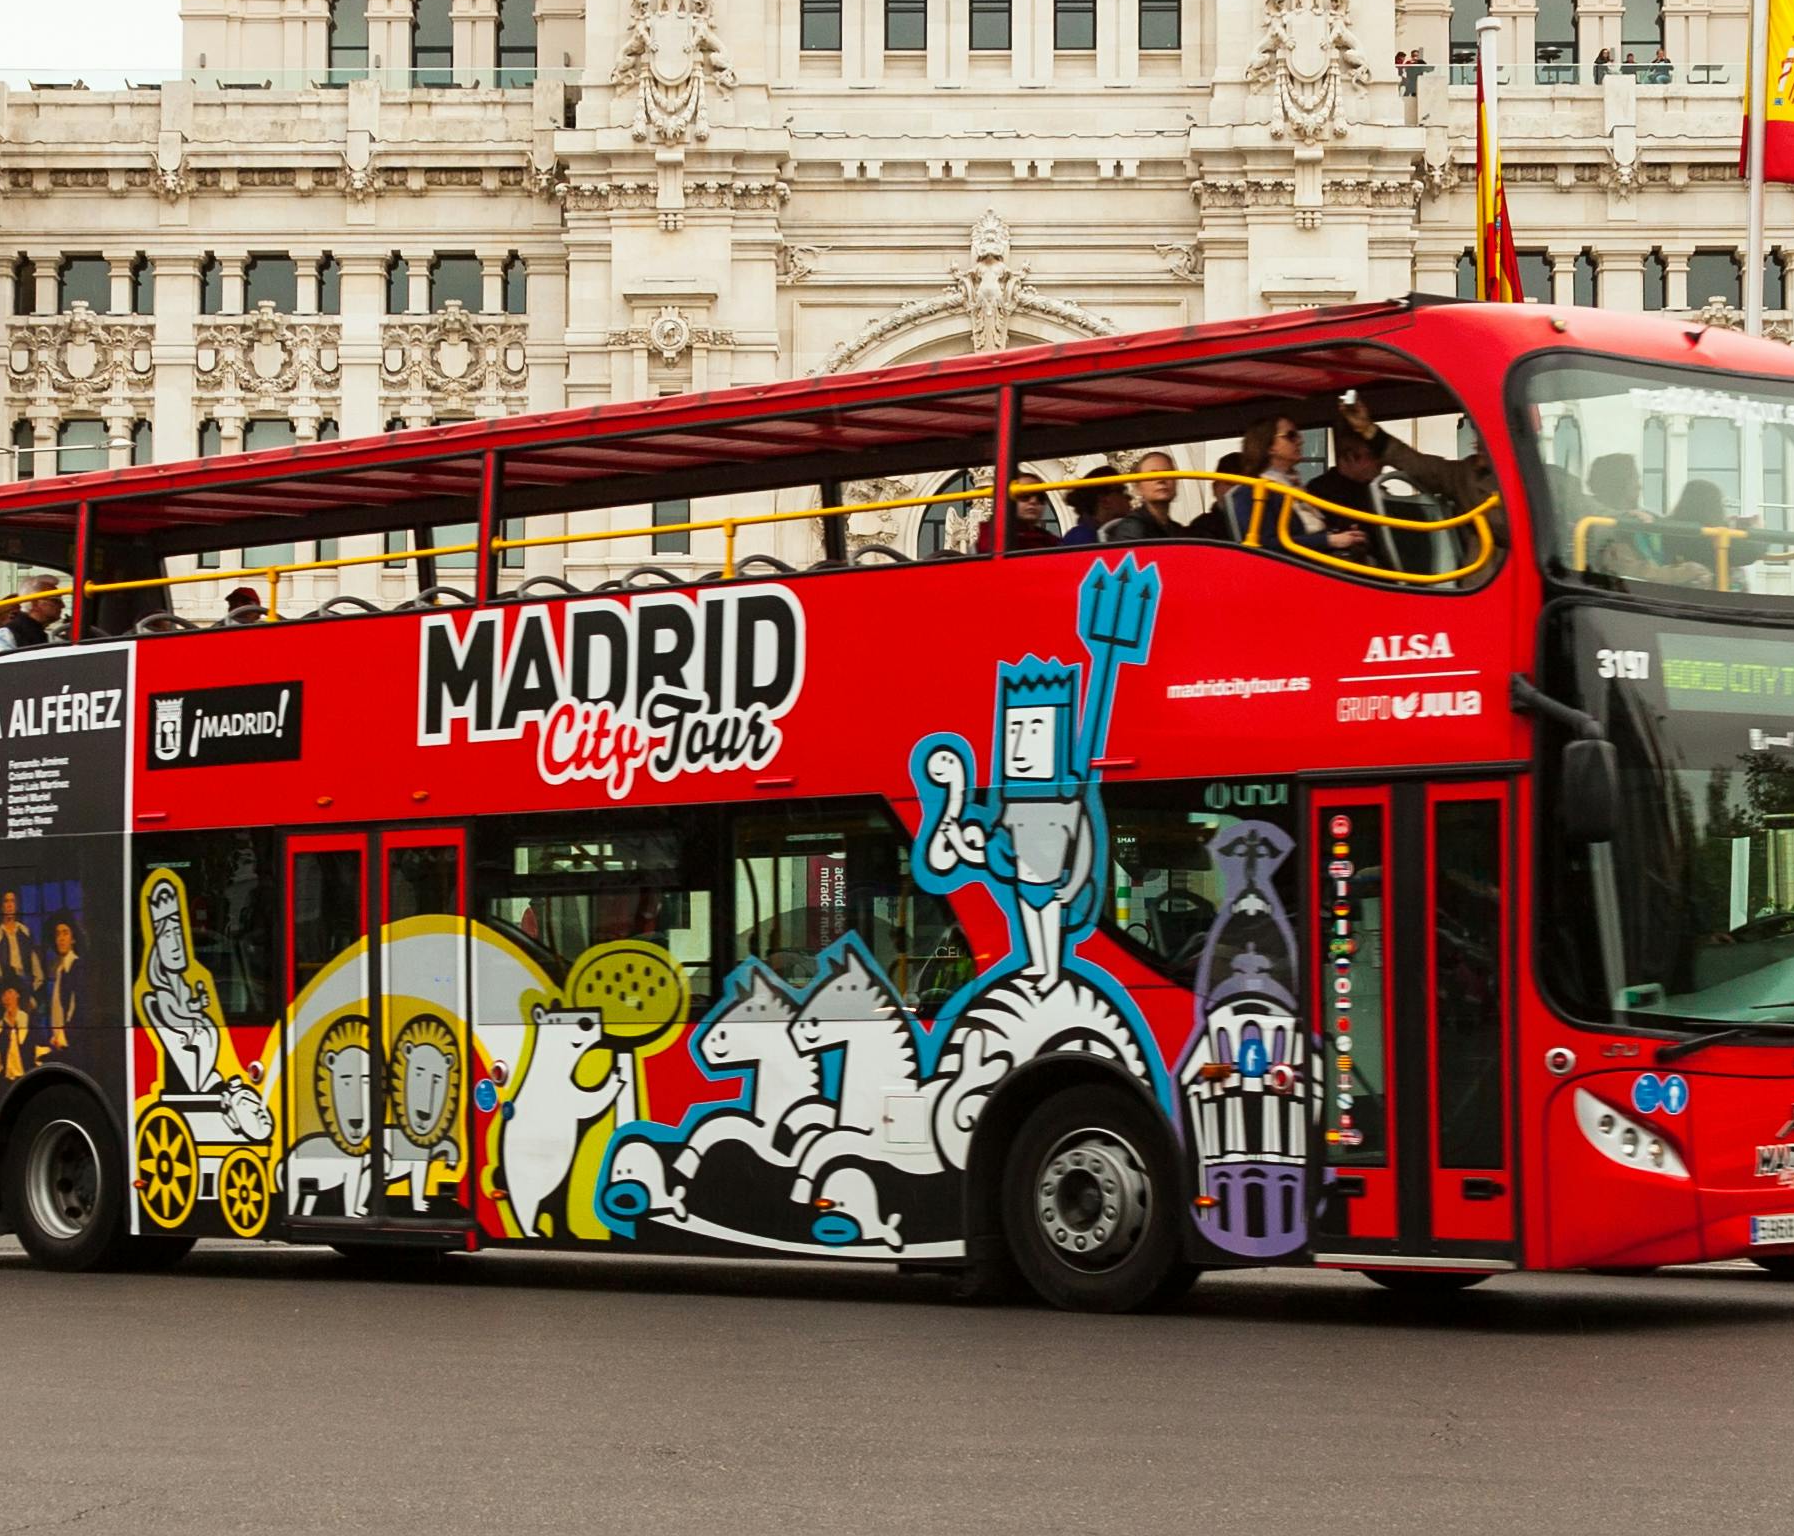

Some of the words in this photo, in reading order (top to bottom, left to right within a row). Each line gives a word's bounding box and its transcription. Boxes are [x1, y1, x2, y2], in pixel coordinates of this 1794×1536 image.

[420, 588, 802, 742] MADRID
[1363, 632, 1455, 663] ALSA
[1596, 648, 1650, 680] 3197
[1167, 677, 1311, 698] madridcitytour.es
[1337, 695, 1391, 722] GRUPO
[8, 684, 123, 739] ALFÉREZ
[189, 689, 290, 758] ¡MADRID!
[543, 702, 647, 792] City
[648, 692, 776, 774] Tour
